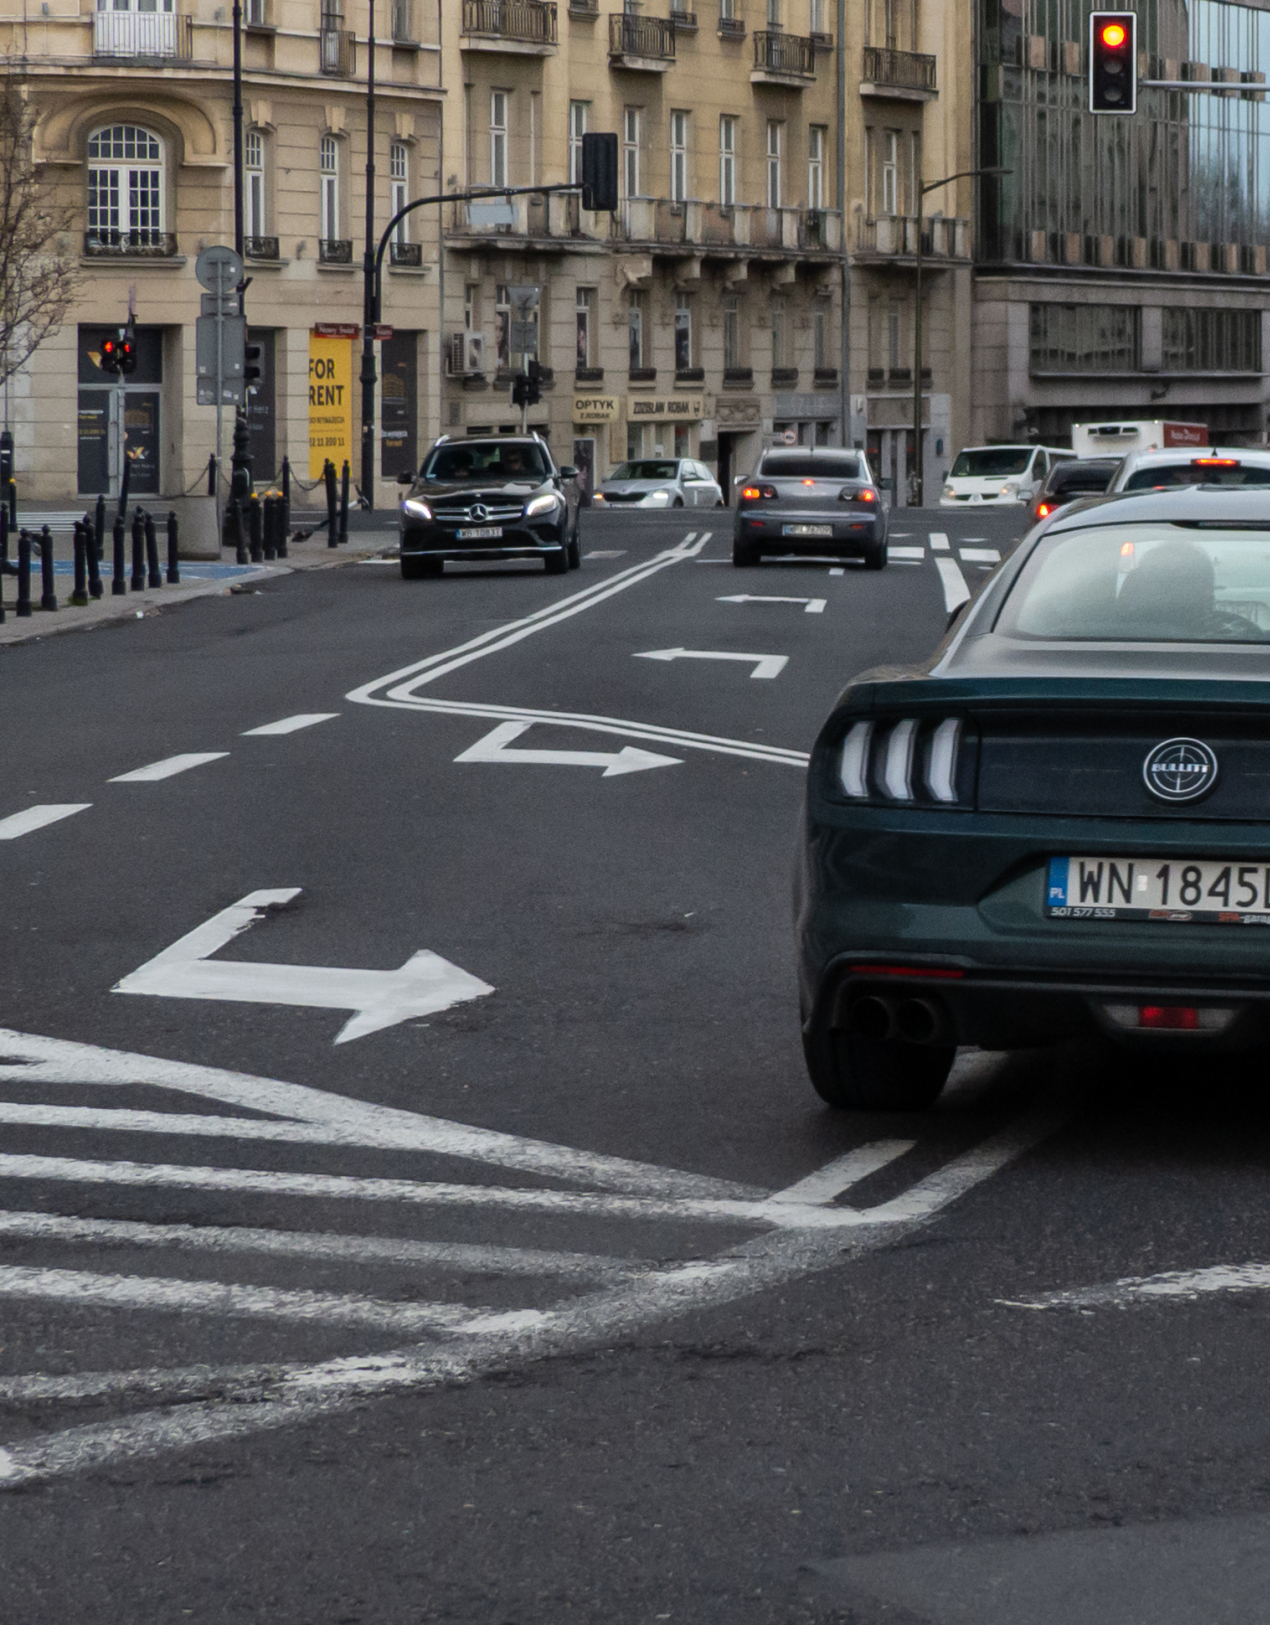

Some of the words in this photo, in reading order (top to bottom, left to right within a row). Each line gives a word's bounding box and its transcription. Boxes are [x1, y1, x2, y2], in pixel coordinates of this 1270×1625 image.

[309, 358, 335, 379] FOR
[309, 385, 345, 406] RENT
[575, 400, 614, 410] OPTYK
[1151, 763, 1210, 773] BULLITT
[1050, 887, 1065, 899] PL
[1078, 861, 1135, 904] WN
[1051, 907, 1072, 916] 501
[1072, 907, 1093, 917] 577
[1094, 908, 1116, 918] 555
